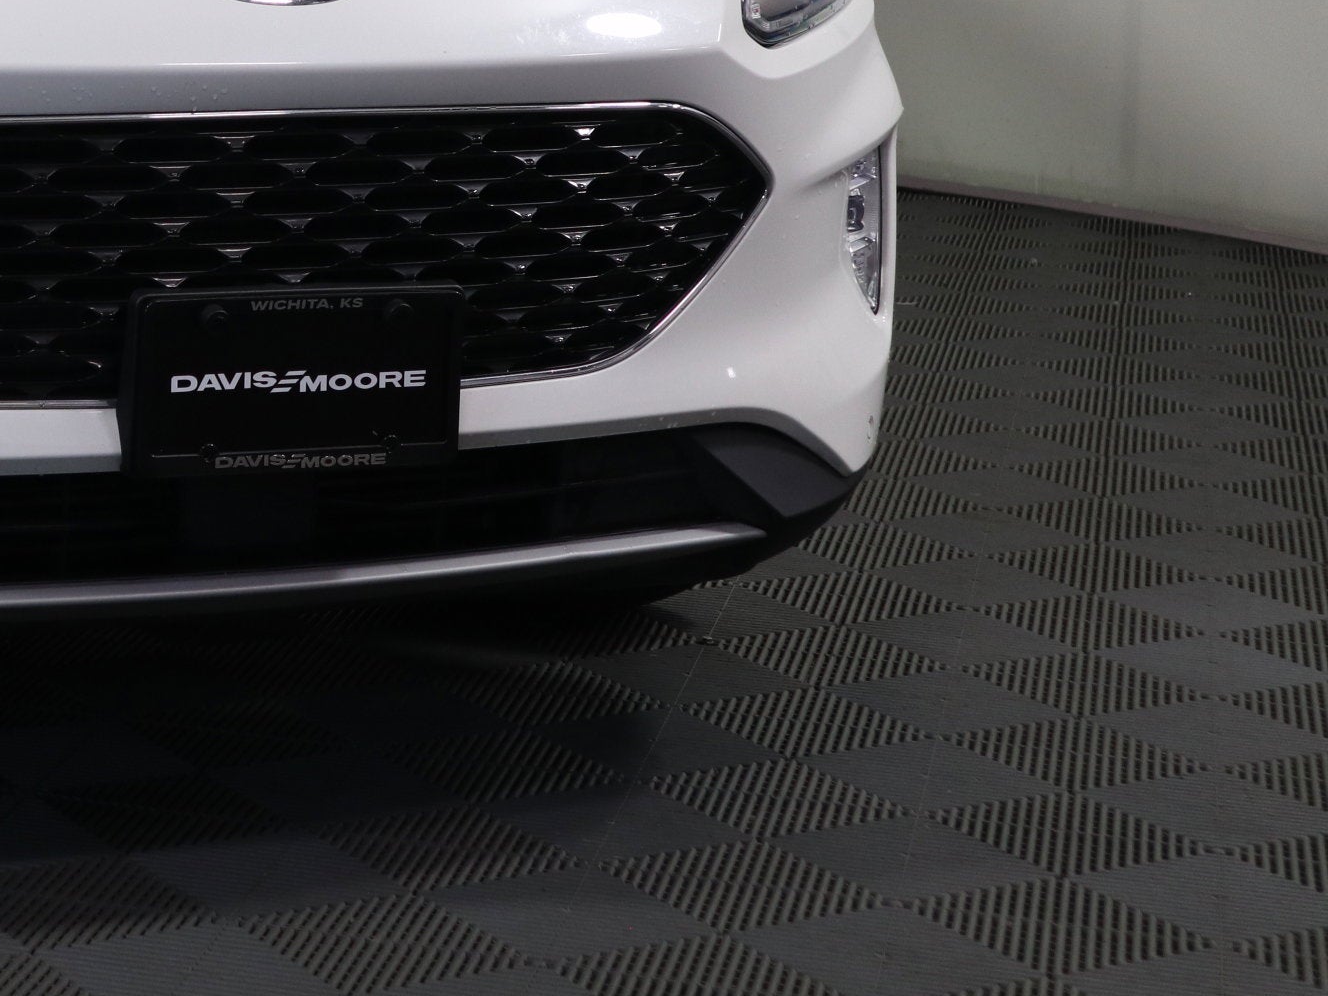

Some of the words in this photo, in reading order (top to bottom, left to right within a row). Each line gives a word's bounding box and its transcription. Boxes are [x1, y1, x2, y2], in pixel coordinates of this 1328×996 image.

[339, 296, 364, 309] KS
[170, 370, 278, 393] DAVIS
[299, 370, 427, 393] MOORE
[214, 454, 286, 469] DAVIS
[300, 453, 387, 469] MOORE
